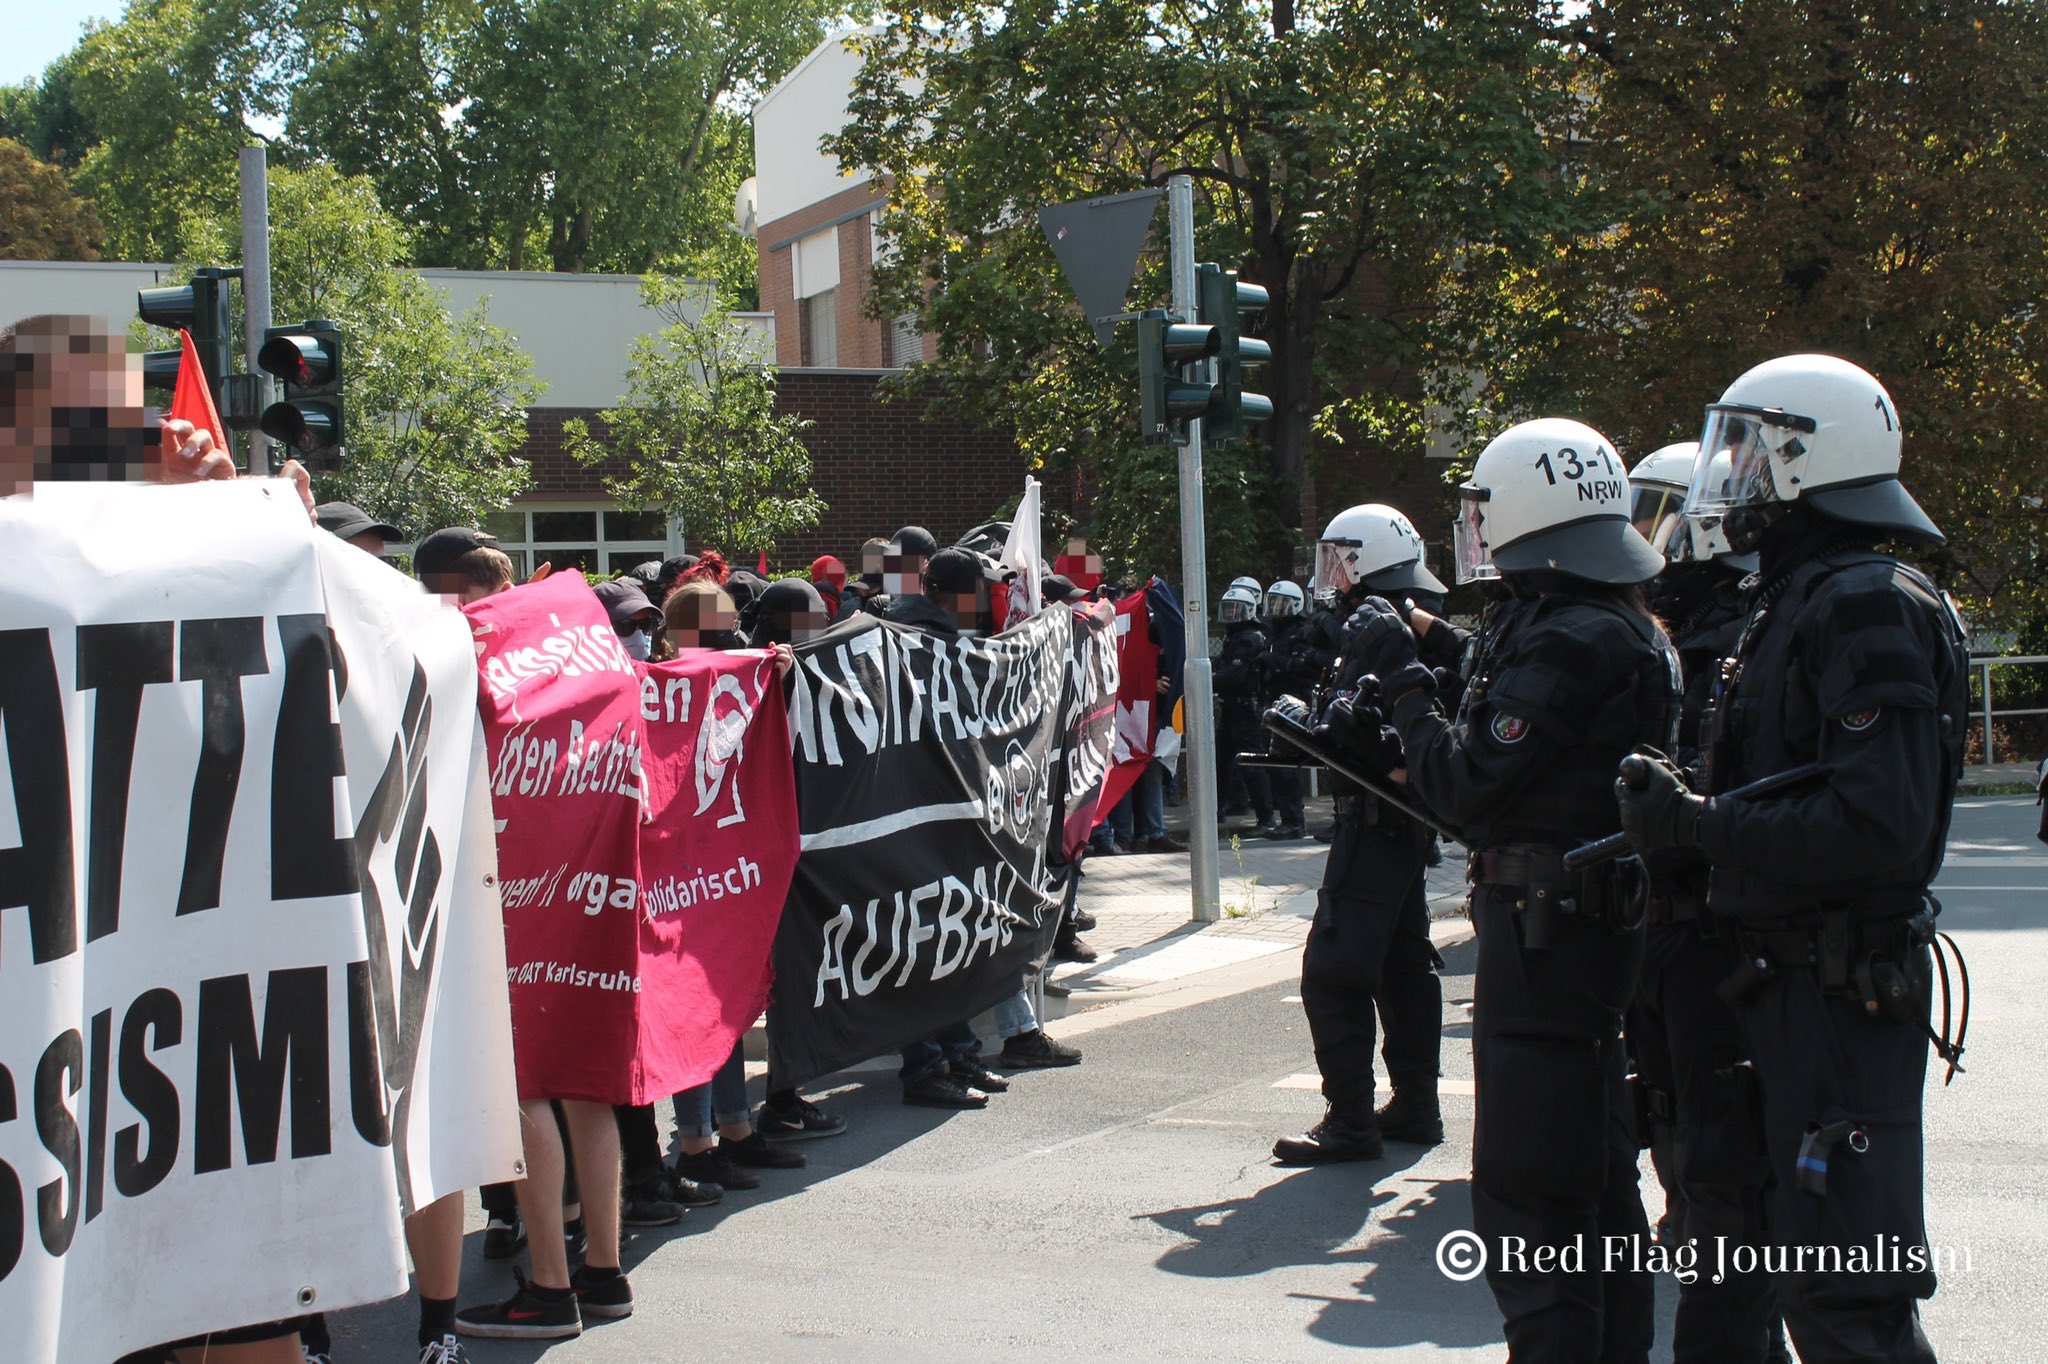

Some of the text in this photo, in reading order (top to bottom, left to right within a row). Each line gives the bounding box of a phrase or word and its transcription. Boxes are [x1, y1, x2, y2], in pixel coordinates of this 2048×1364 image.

[1156, 423, 1165, 433] 27
[1577, 480, 1622, 501] NRW
[518, 962, 544, 984] OAT
[545, 961, 642, 993] Karlsruhe
